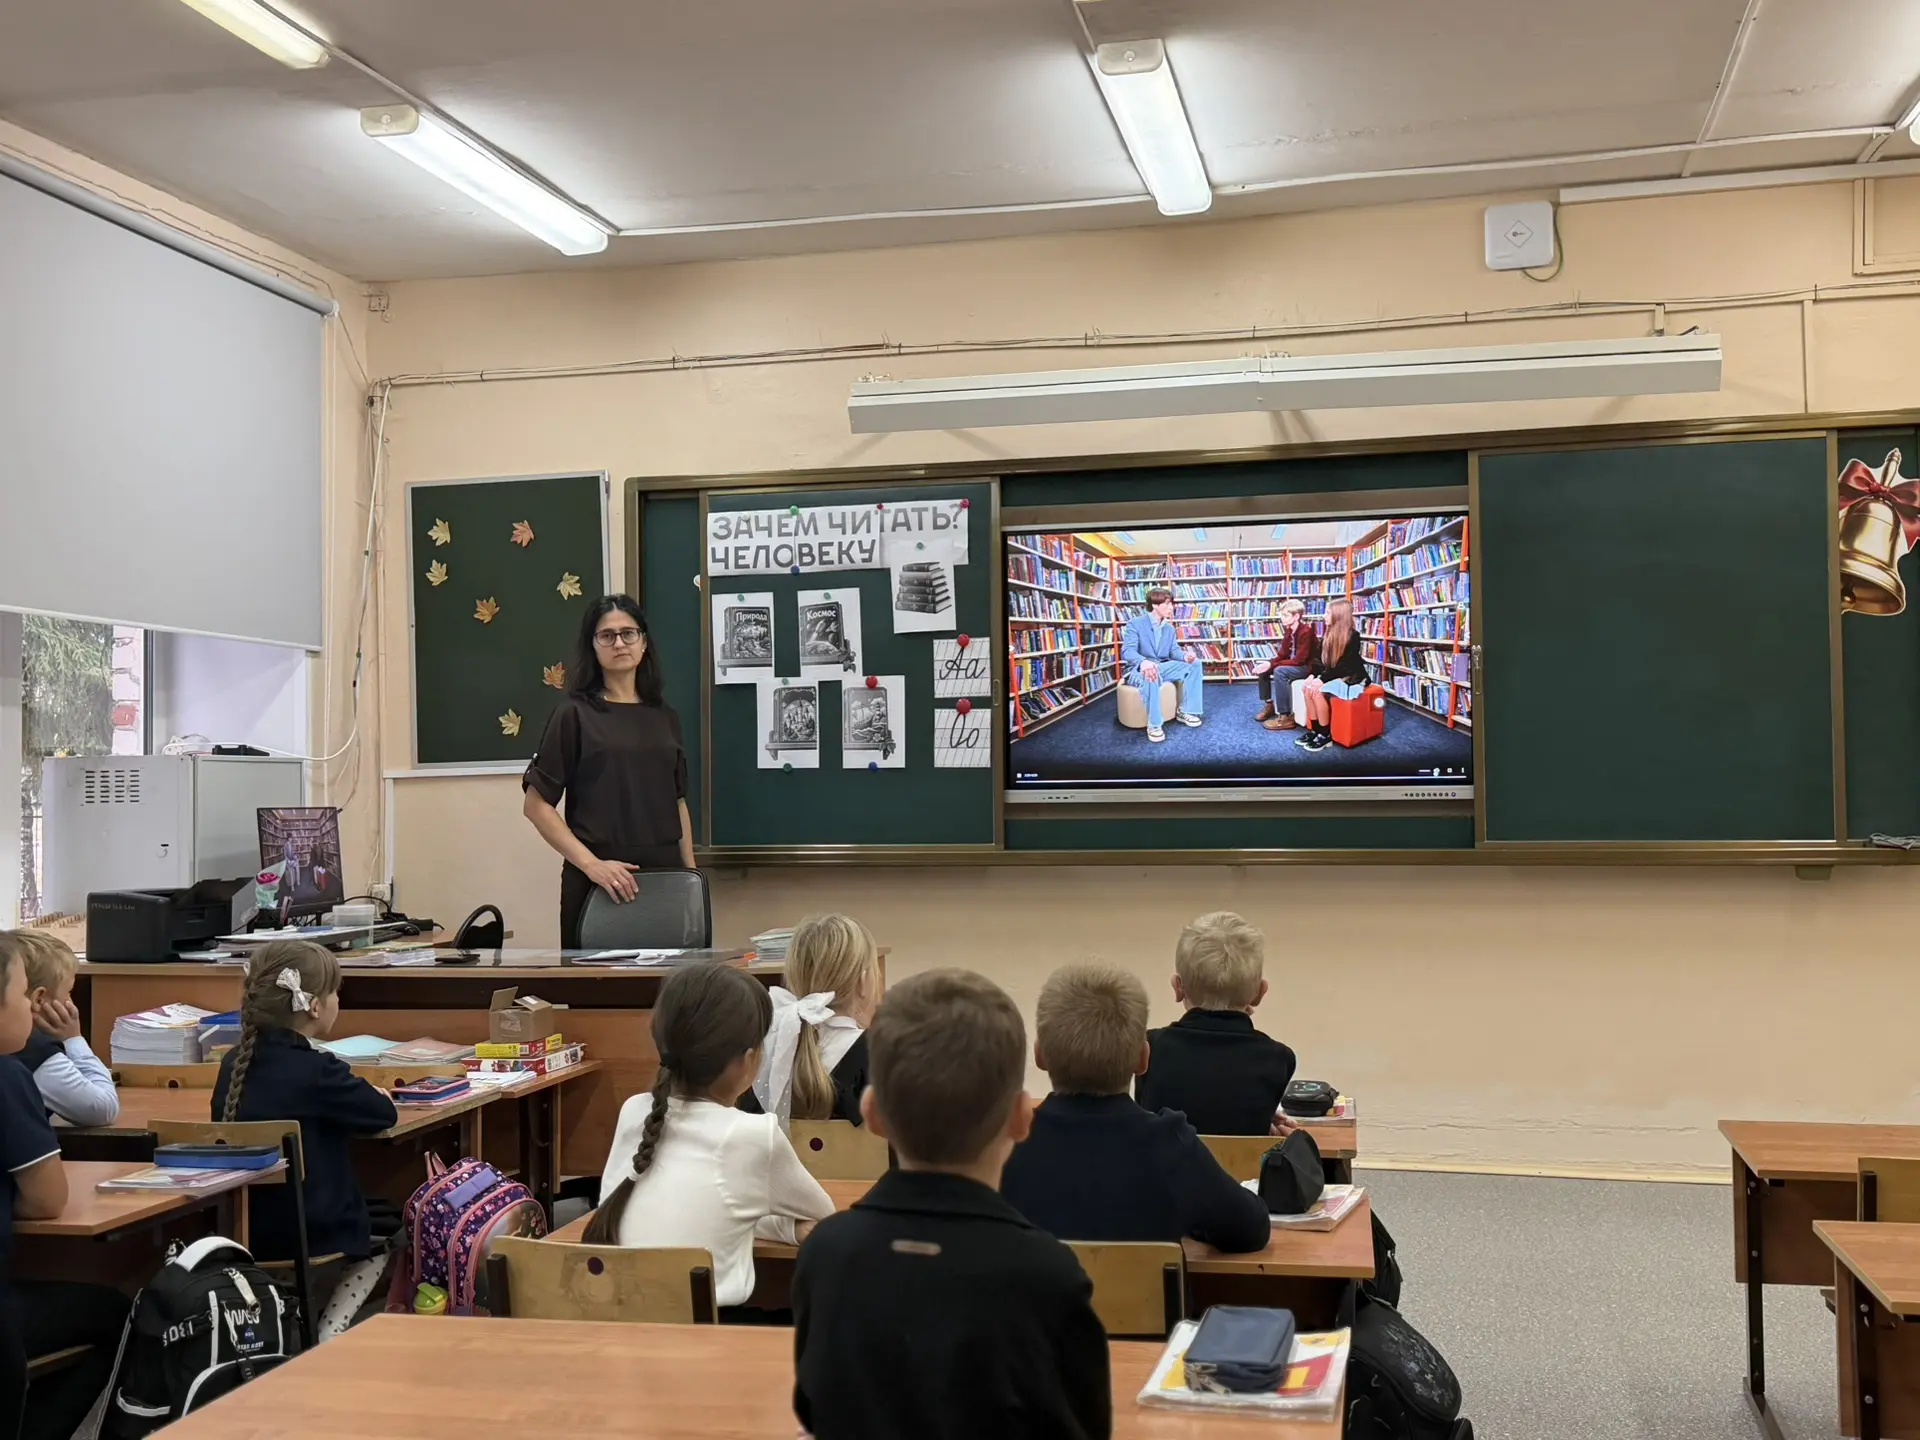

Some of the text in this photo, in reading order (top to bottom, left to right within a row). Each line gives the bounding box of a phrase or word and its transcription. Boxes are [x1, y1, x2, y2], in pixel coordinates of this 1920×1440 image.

[712, 503, 963, 540] ЗАЧЕМ ЧИТАТЬ?
[711, 538, 876, 570] ЧЕЛОВЕКУ
[736, 611, 768, 622] Природа
[806, 609, 837, 620] Космос
